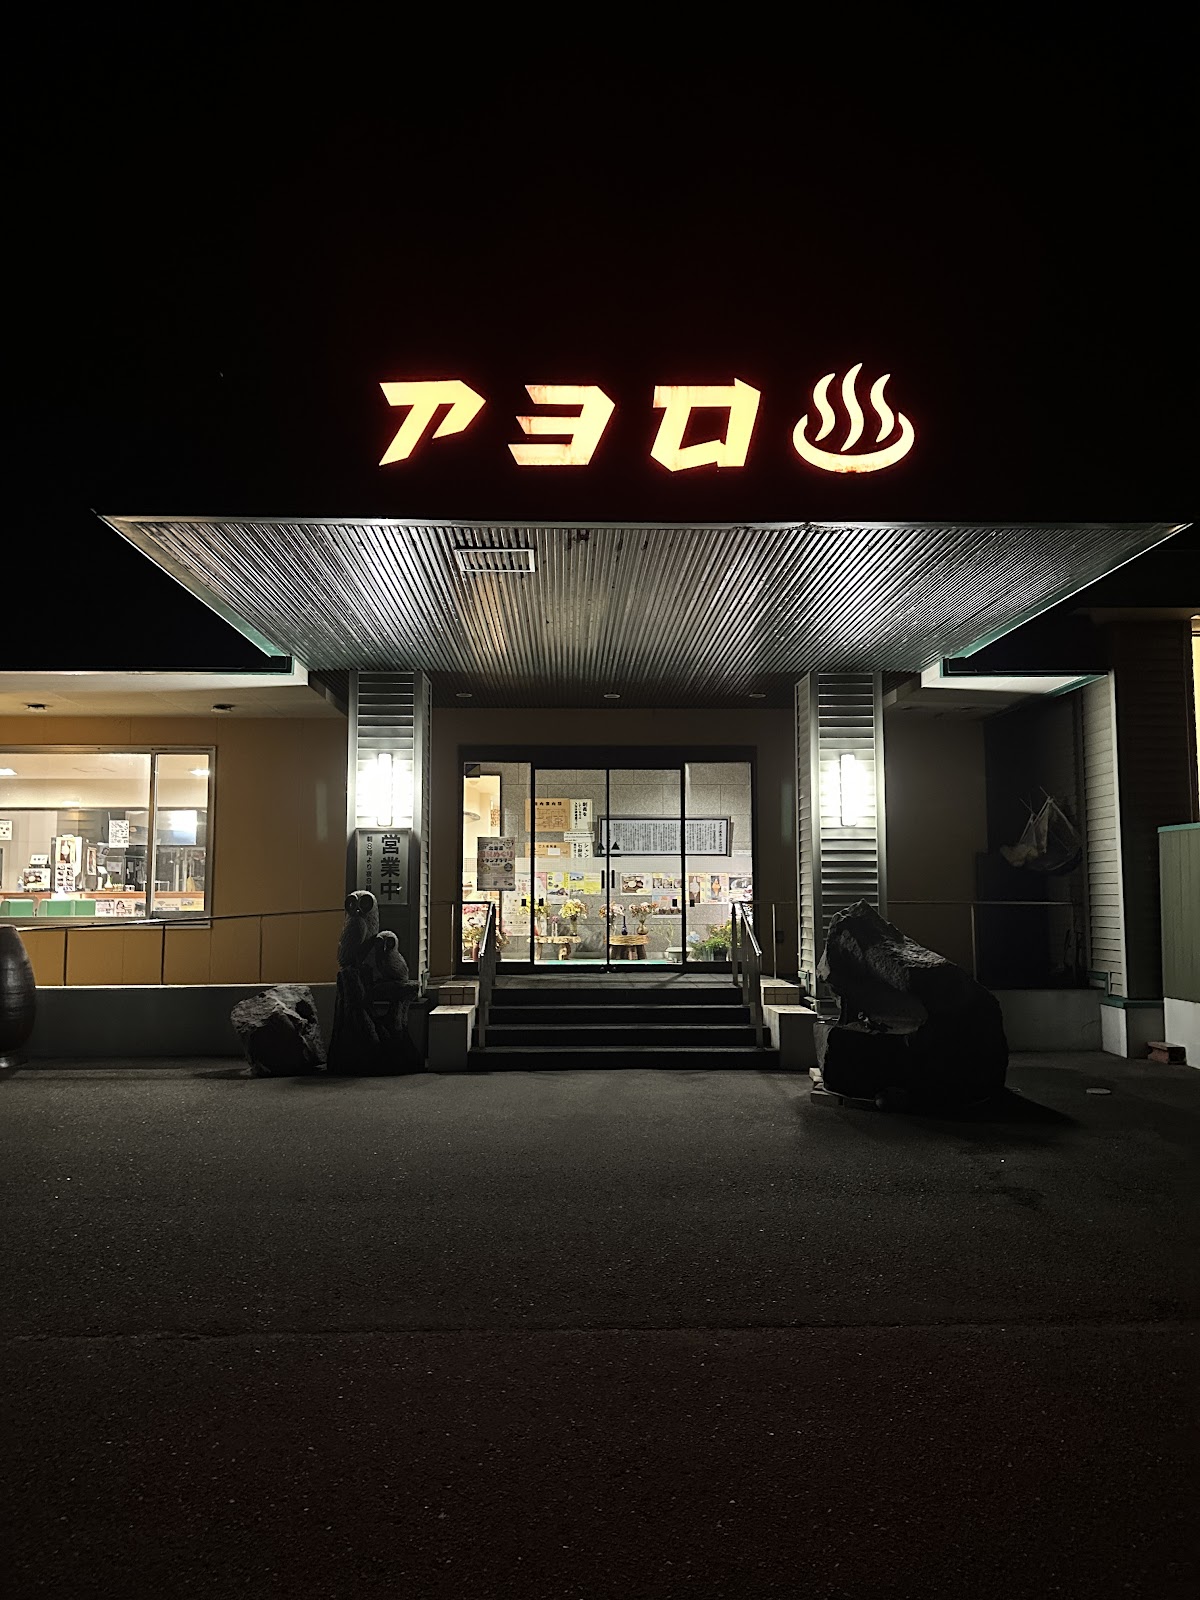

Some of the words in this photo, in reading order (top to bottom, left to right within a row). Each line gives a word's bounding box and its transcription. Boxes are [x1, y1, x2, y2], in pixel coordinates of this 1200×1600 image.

[379, 378, 761, 472] アヨロ
[380, 834, 401, 901] 営業中
